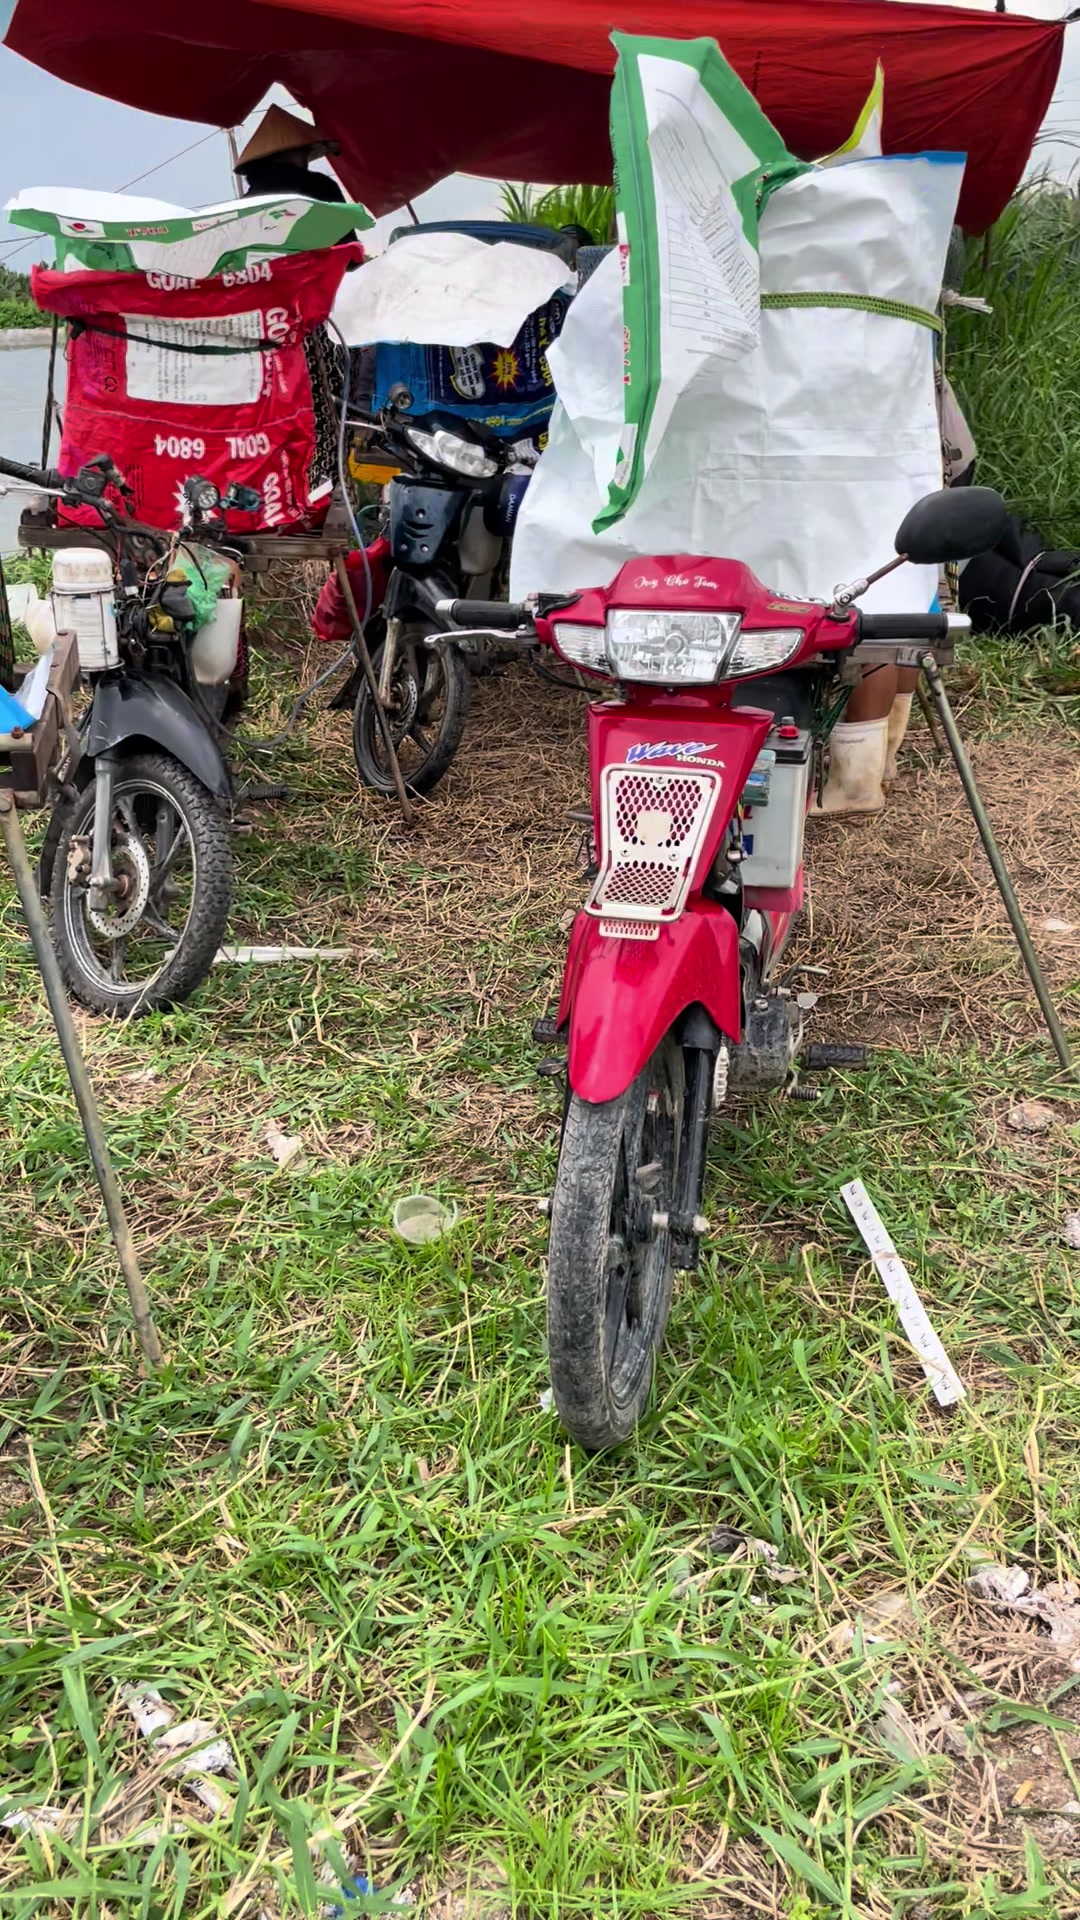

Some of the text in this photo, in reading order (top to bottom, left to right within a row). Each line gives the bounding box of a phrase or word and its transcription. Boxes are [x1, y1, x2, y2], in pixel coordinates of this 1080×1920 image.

[153, 432, 271, 460] GOAL 6804
[262, 472, 285, 527] GOAL
[626, 741, 719, 764] Wave
[676, 754, 727, 769] HONDA
